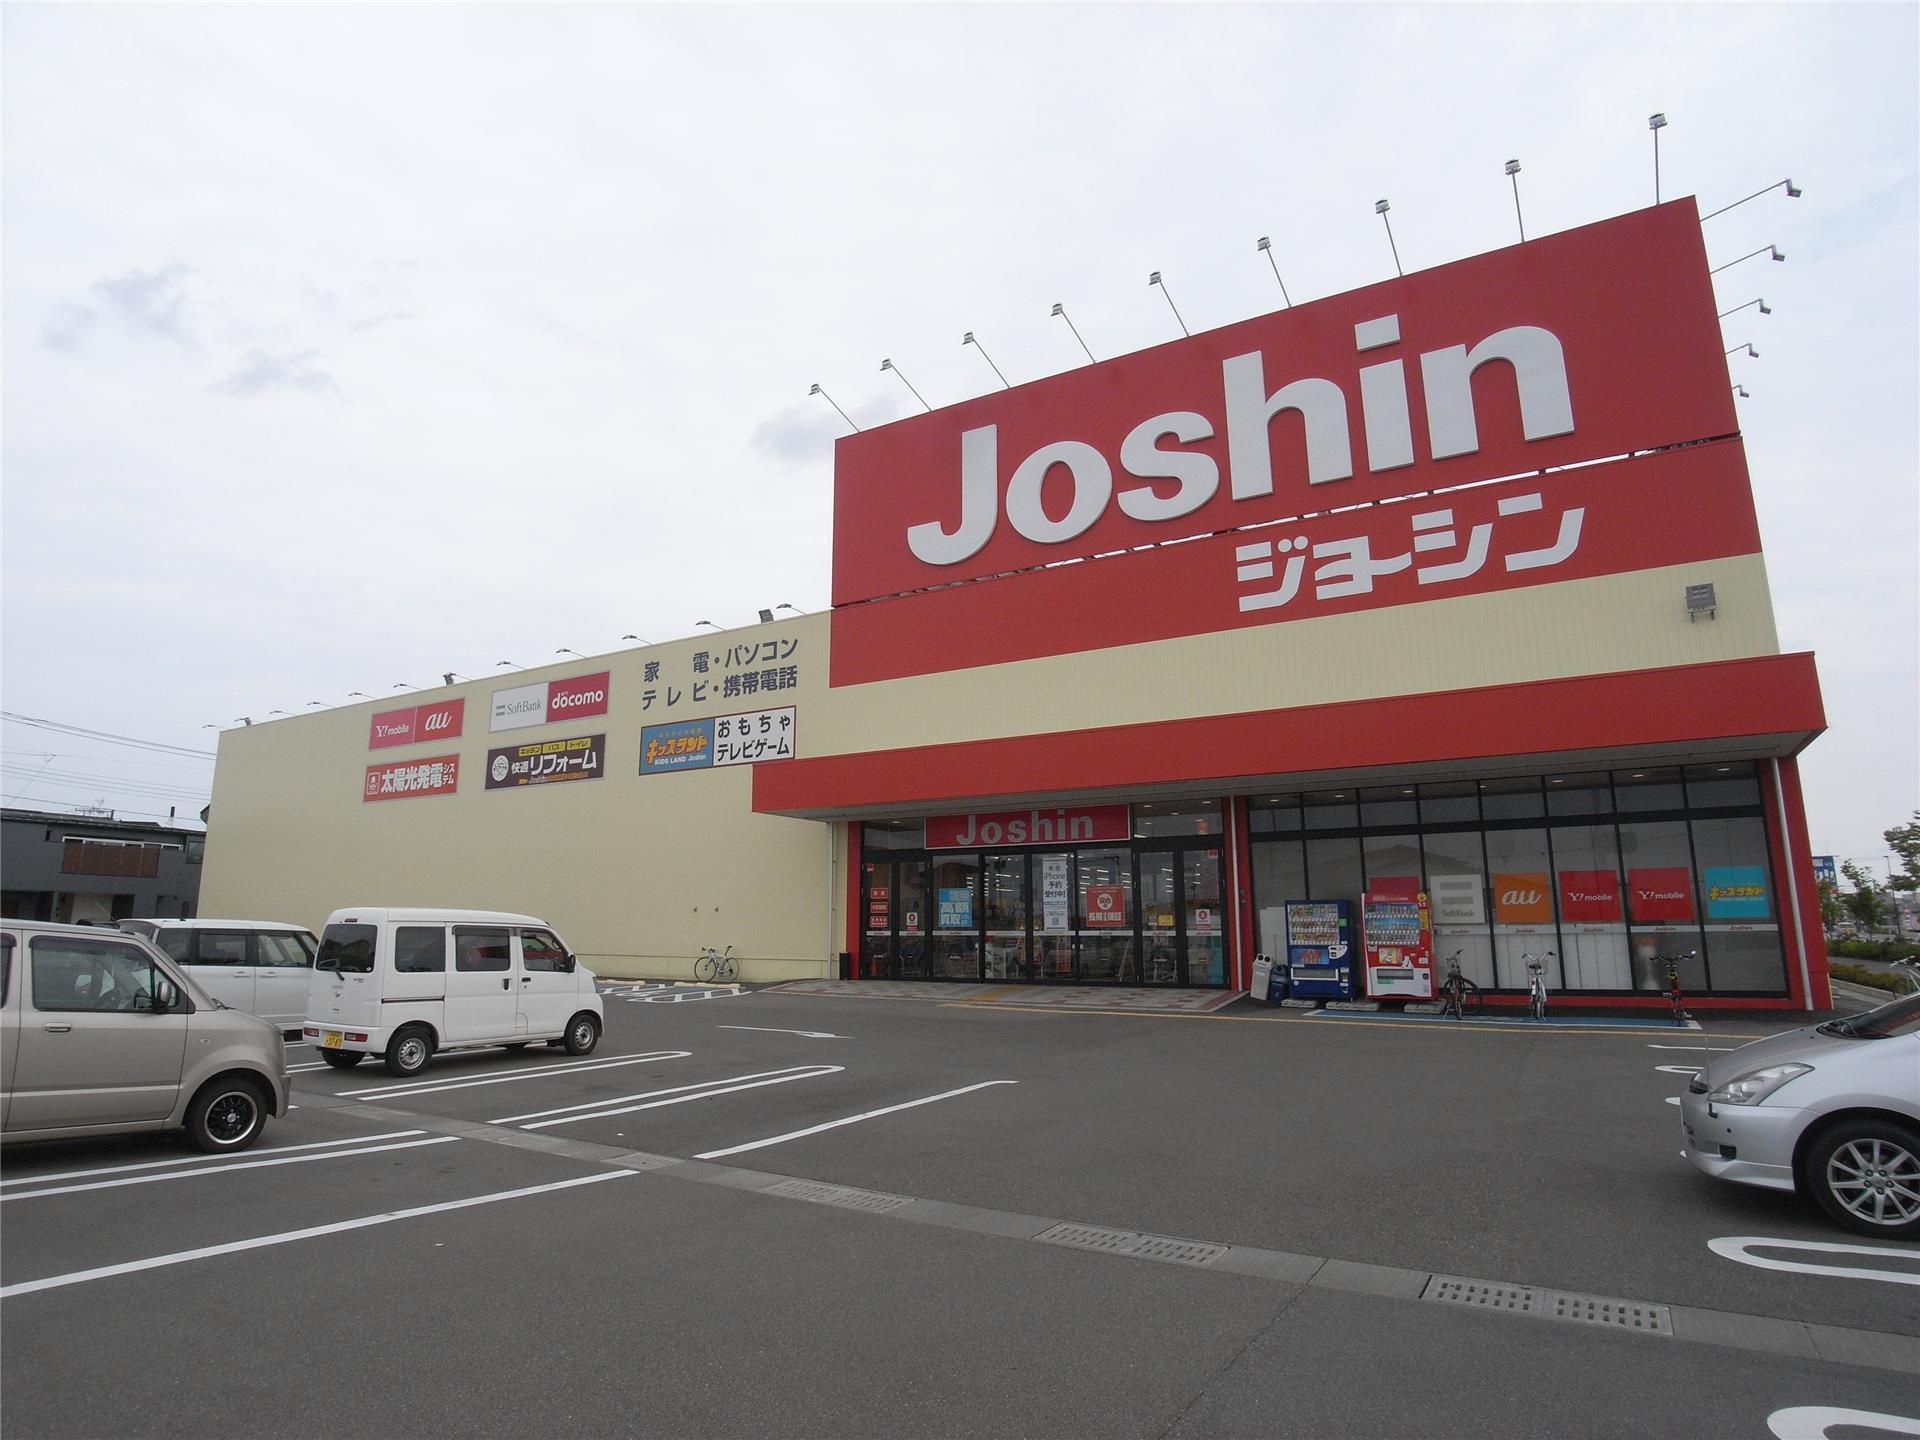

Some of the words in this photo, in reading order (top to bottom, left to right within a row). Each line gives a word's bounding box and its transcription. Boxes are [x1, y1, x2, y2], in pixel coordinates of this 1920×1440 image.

[907, 313, 1576, 566] Joshin
[1237, 491, 1586, 612] ジョーシン
[642, 665, 798, 711] テレビ・携帯電話
[507, 699, 542, 715] SoftBank
[552, 690, 604, 709] docomo
[425, 711, 452, 731] au
[718, 715, 791, 739] おもちゃ
[569, 740, 588, 749] トイレ
[717, 736, 790, 763] テレビゲーム
[655, 756, 669, 766] KIDS
[670, 754, 687, 764] LAND
[956, 810, 1094, 846] Joshin
[1048, 881, 1063, 890] 予約
[1502, 889, 1543, 905] au
[1441, 910, 1474, 918] SoftBank
